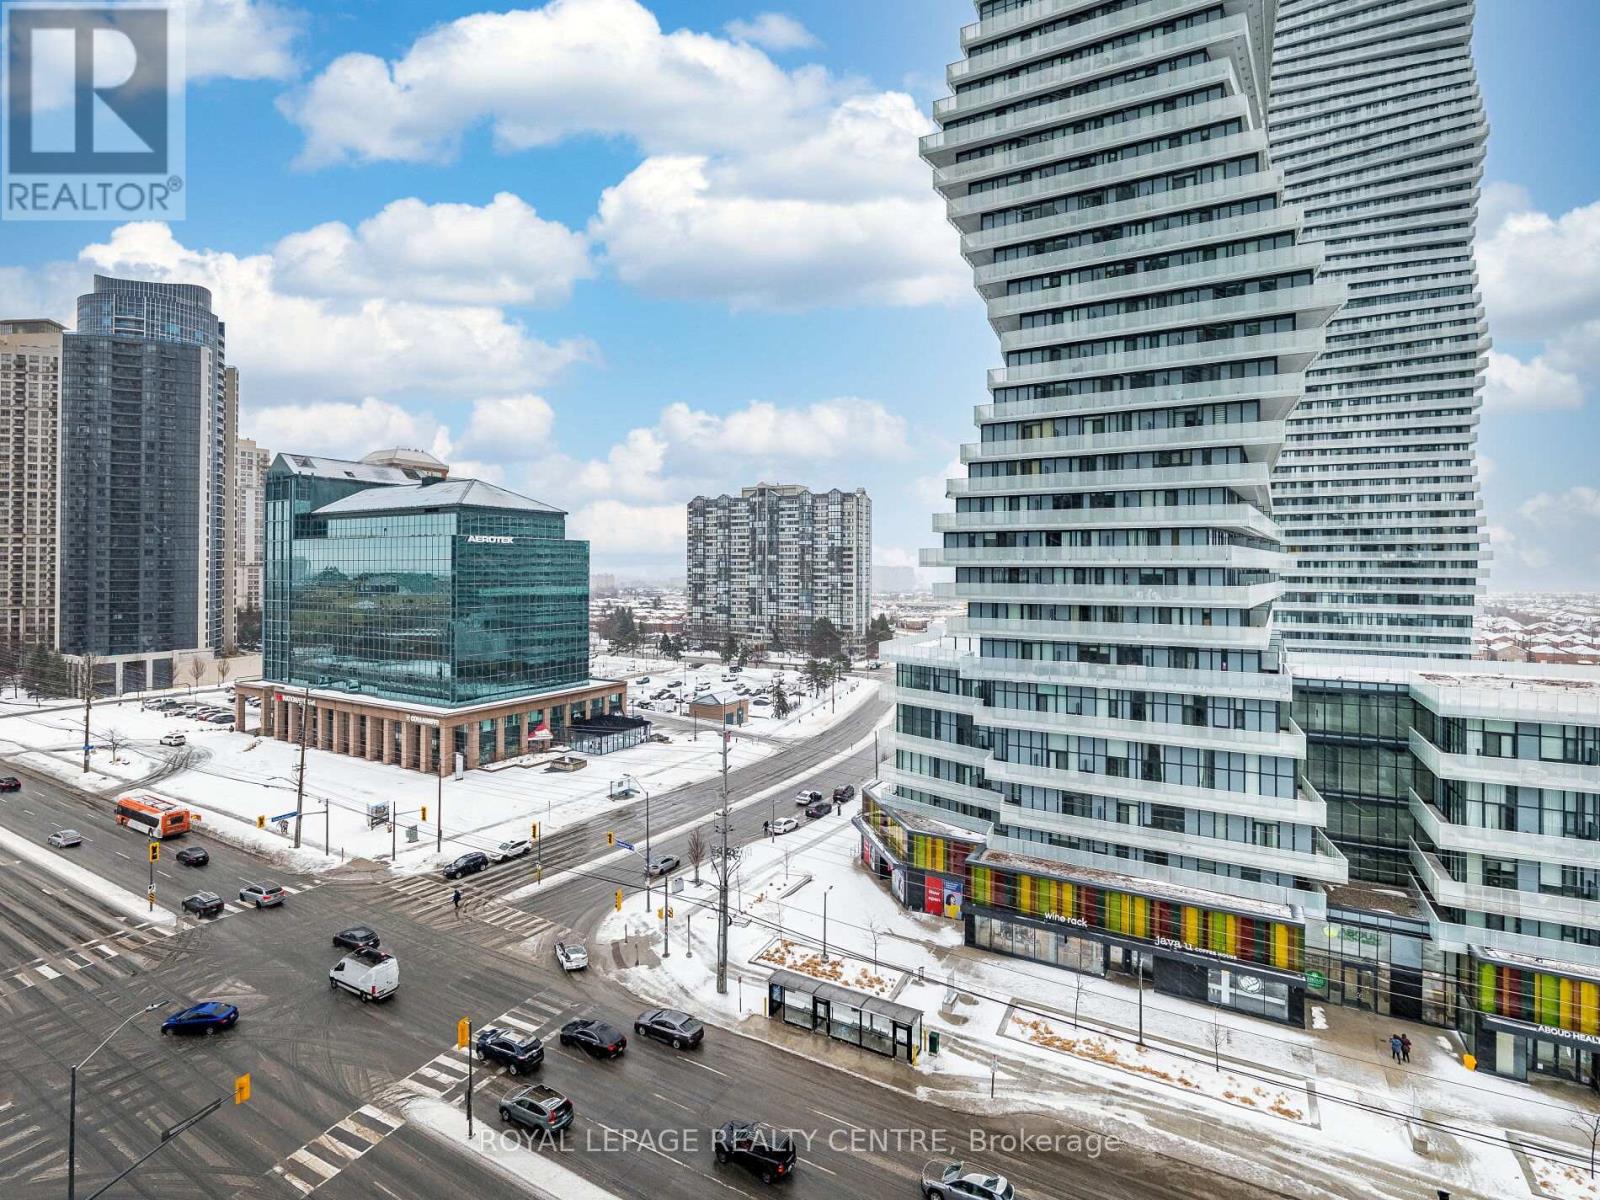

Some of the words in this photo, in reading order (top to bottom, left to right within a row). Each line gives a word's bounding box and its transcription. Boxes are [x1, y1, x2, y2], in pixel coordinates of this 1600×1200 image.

[467, 534, 514, 544] AEROTEK
[1044, 911, 1066, 923] wine
[1067, 917, 1088, 928] rack
[1538, 1024, 1571, 1038] ABOUD
